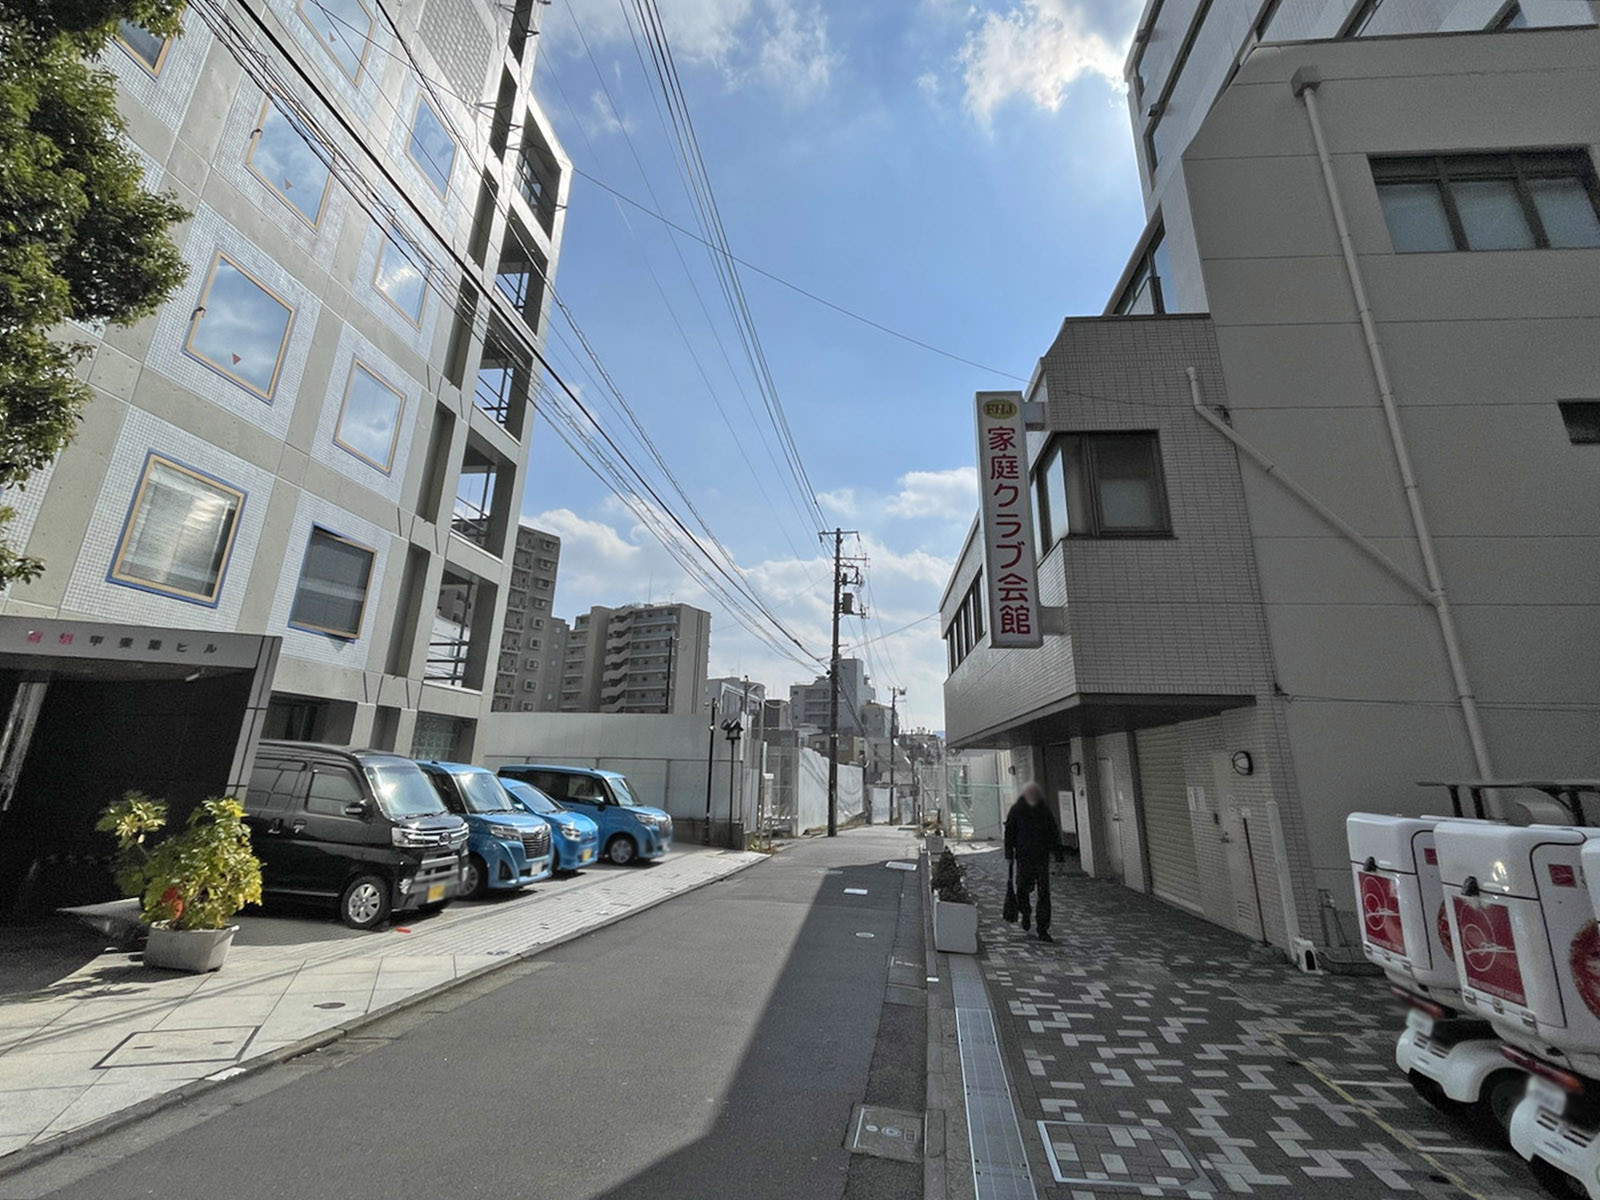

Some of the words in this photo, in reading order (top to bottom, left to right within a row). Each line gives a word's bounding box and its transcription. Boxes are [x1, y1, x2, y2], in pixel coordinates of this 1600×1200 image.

[988, 426, 1031, 635] 家庭クラブ会館
